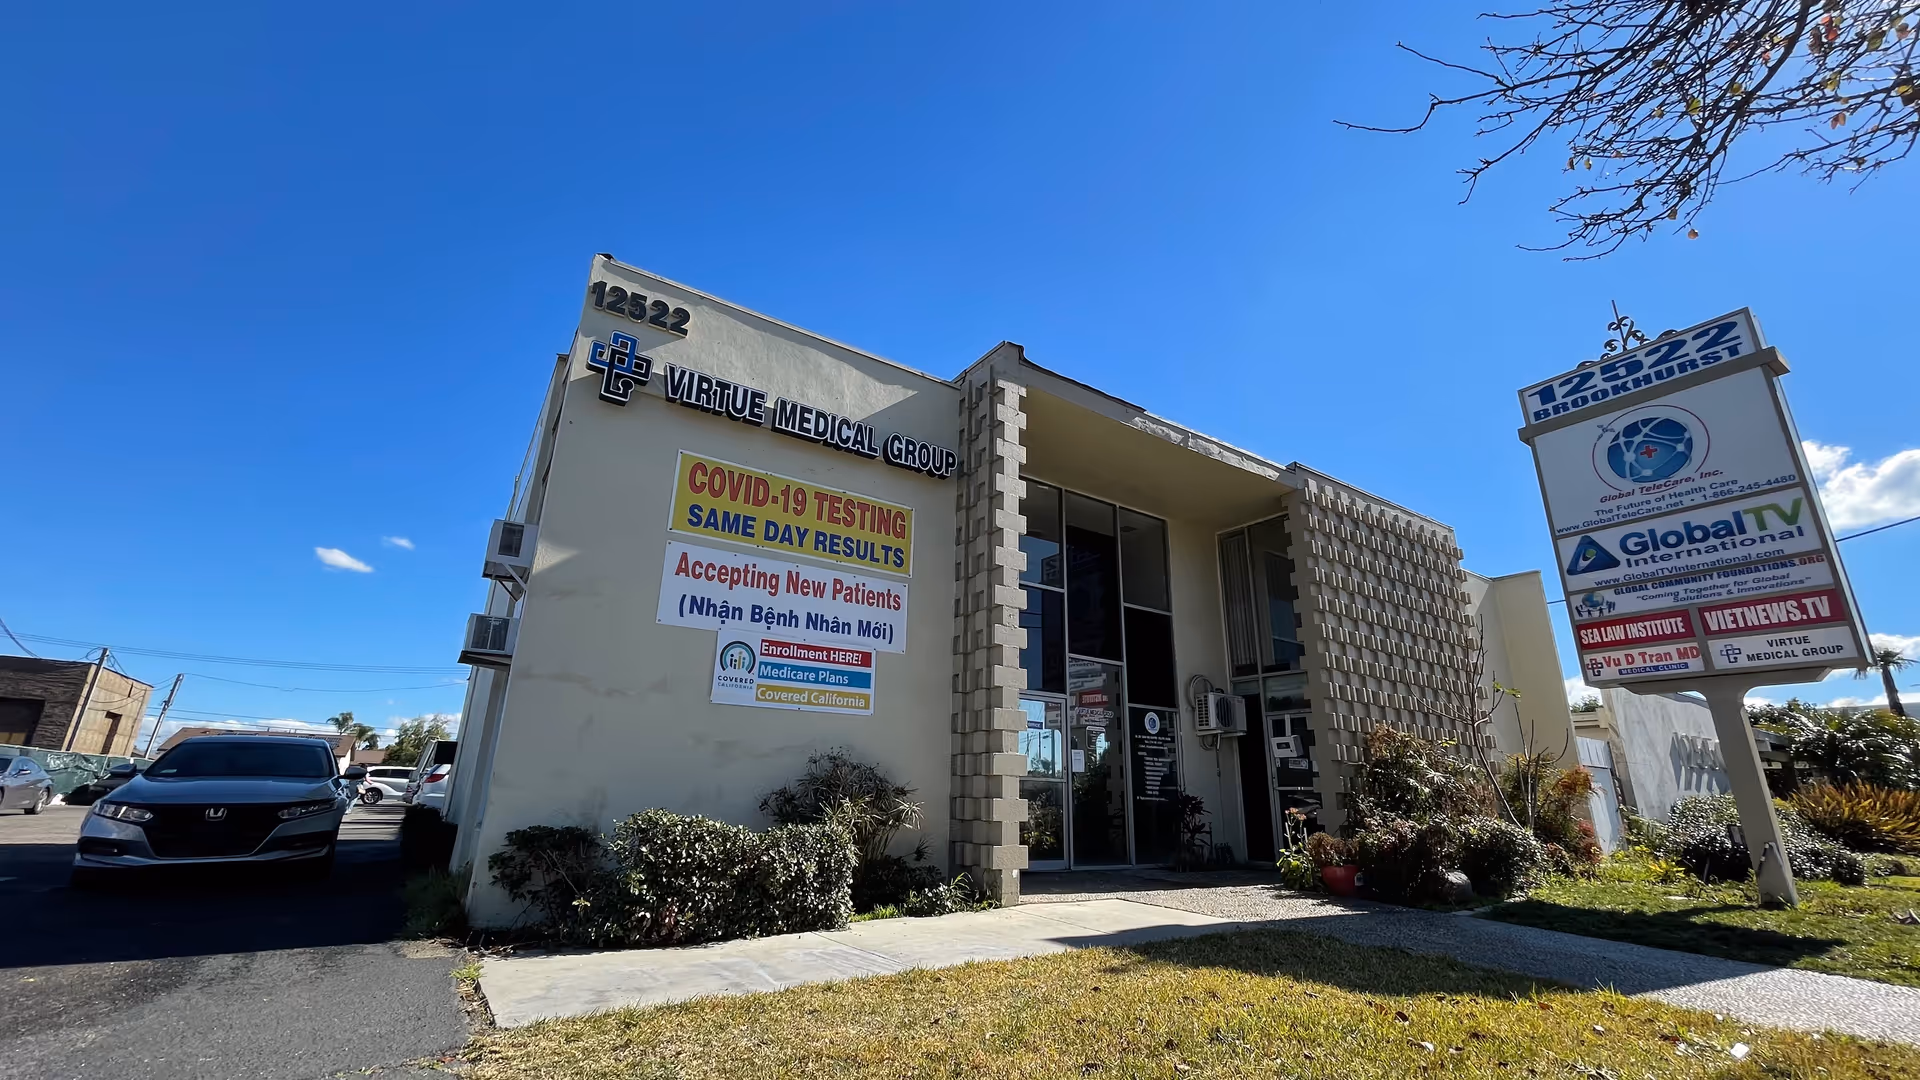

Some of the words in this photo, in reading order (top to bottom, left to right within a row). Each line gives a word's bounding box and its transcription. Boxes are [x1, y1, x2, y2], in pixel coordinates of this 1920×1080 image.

[591, 281, 691, 338] 12522
[1528, 321, 1741, 407] 12522
[1533, 342, 1744, 422] BROOKHURST
[664, 362, 768, 426] VIRTUE
[772, 396, 880, 459] MEDICAL
[883, 433, 958, 479] GROUP
[688, 462, 807, 516] COVID-19
[814, 491, 906, 539] TESTING
[1556, 500, 1684, 534] www.GlobalTeleCare.net
[1702, 473, 1796, 500] 1-866-245-4480
[1594, 507, 1614, 517] The
[1616, 498, 1651, 512] Future
[1655, 494, 1667, 502] of
[1669, 485, 1703, 500] Health
[1709, 479, 1738, 490] Care
[1600, 488, 1634, 504] Global
[1639, 475, 1695, 495] TeleCare,
[1700, 469, 1723, 479] Inc.
[687, 504, 756, 538] SAME
[764, 519, 809, 548] DAY
[814, 530, 905, 568] RESULTS
[1619, 497, 1804, 556] GlobalTV
[1626, 526, 1804, 569] International
[674, 552, 779, 596] Accepting
[786, 570, 827, 599] New
[832, 578, 901, 611] Patients
[1594, 548, 1785, 587] www.GlobalTVInternational.com
[1614, 580, 1650, 596] GLOBAL
[1651, 572, 1715, 590] COMMUNITY
[1717, 554, 1825, 579] FOUNDATIONS.ORG
[1683, 582, 1730, 597] Together
[1733, 578, 1749, 588] for
[1752, 572, 1790, 584] Global
[1673, 591, 1722, 603] Solutions
[1726, 587, 1735, 596] &
[1703, 595, 1832, 632] VIETNEWS.TV
[678, 594, 743, 624] (Nhận
[750, 604, 799, 630] Bệnh
[805, 612, 851, 635] Nhân
[857, 619, 894, 644] Mới)
[1580, 627, 1601, 645] SEA
[1601, 622, 1626, 642] LAW
[1627, 617, 1686, 639] INSTITUTE
[761, 642, 827, 661] Enrollment
[830, 651, 862, 664] HERE!
[1603, 654, 1622, 668] Vu
[1625, 652, 1636, 666] D
[1638, 648, 1673, 664] Tran
[1676, 645, 1701, 660] MD
[1746, 650, 1799, 662] MEDICAL
[1802, 644, 1844, 657] GROUP
[1766, 635, 1811, 648] VIRTUE
[717, 675, 754, 685] COVERED
[759, 664, 816, 681] Medicare
[819, 671, 849, 684] Plans
[1621, 665, 1657, 675] MEDICAL
[1658, 662, 1687, 672] CLINIC
[757, 687, 808, 702] Covered
[811, 692, 865, 707] California
